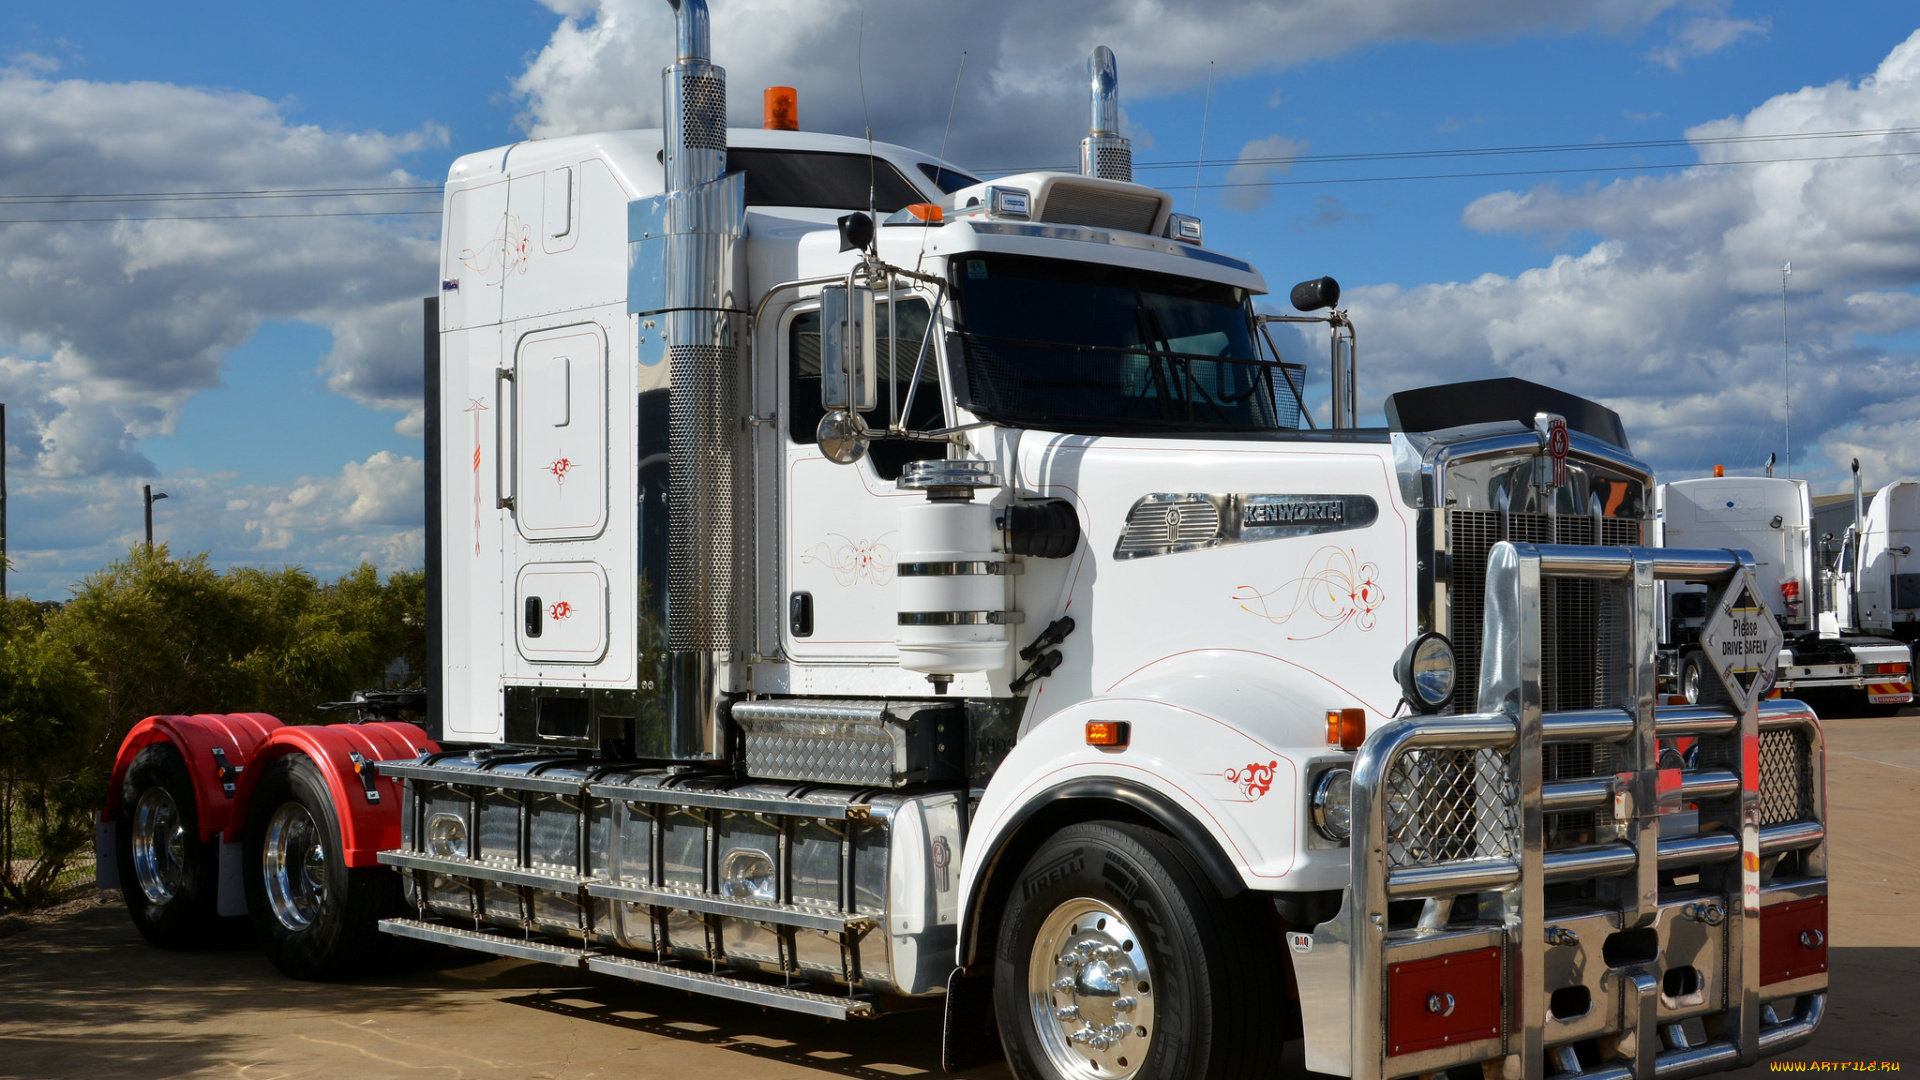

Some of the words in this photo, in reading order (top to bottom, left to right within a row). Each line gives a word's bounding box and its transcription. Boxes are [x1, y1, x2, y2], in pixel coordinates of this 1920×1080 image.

[1244, 501, 1342, 522] KENWORTH
[1733, 620, 1757, 637] Please
[1722, 641, 1742, 655] DRIVE
[1743, 640, 1767, 655] SAFELY
[1023, 848, 1086, 900] PIRELLI
